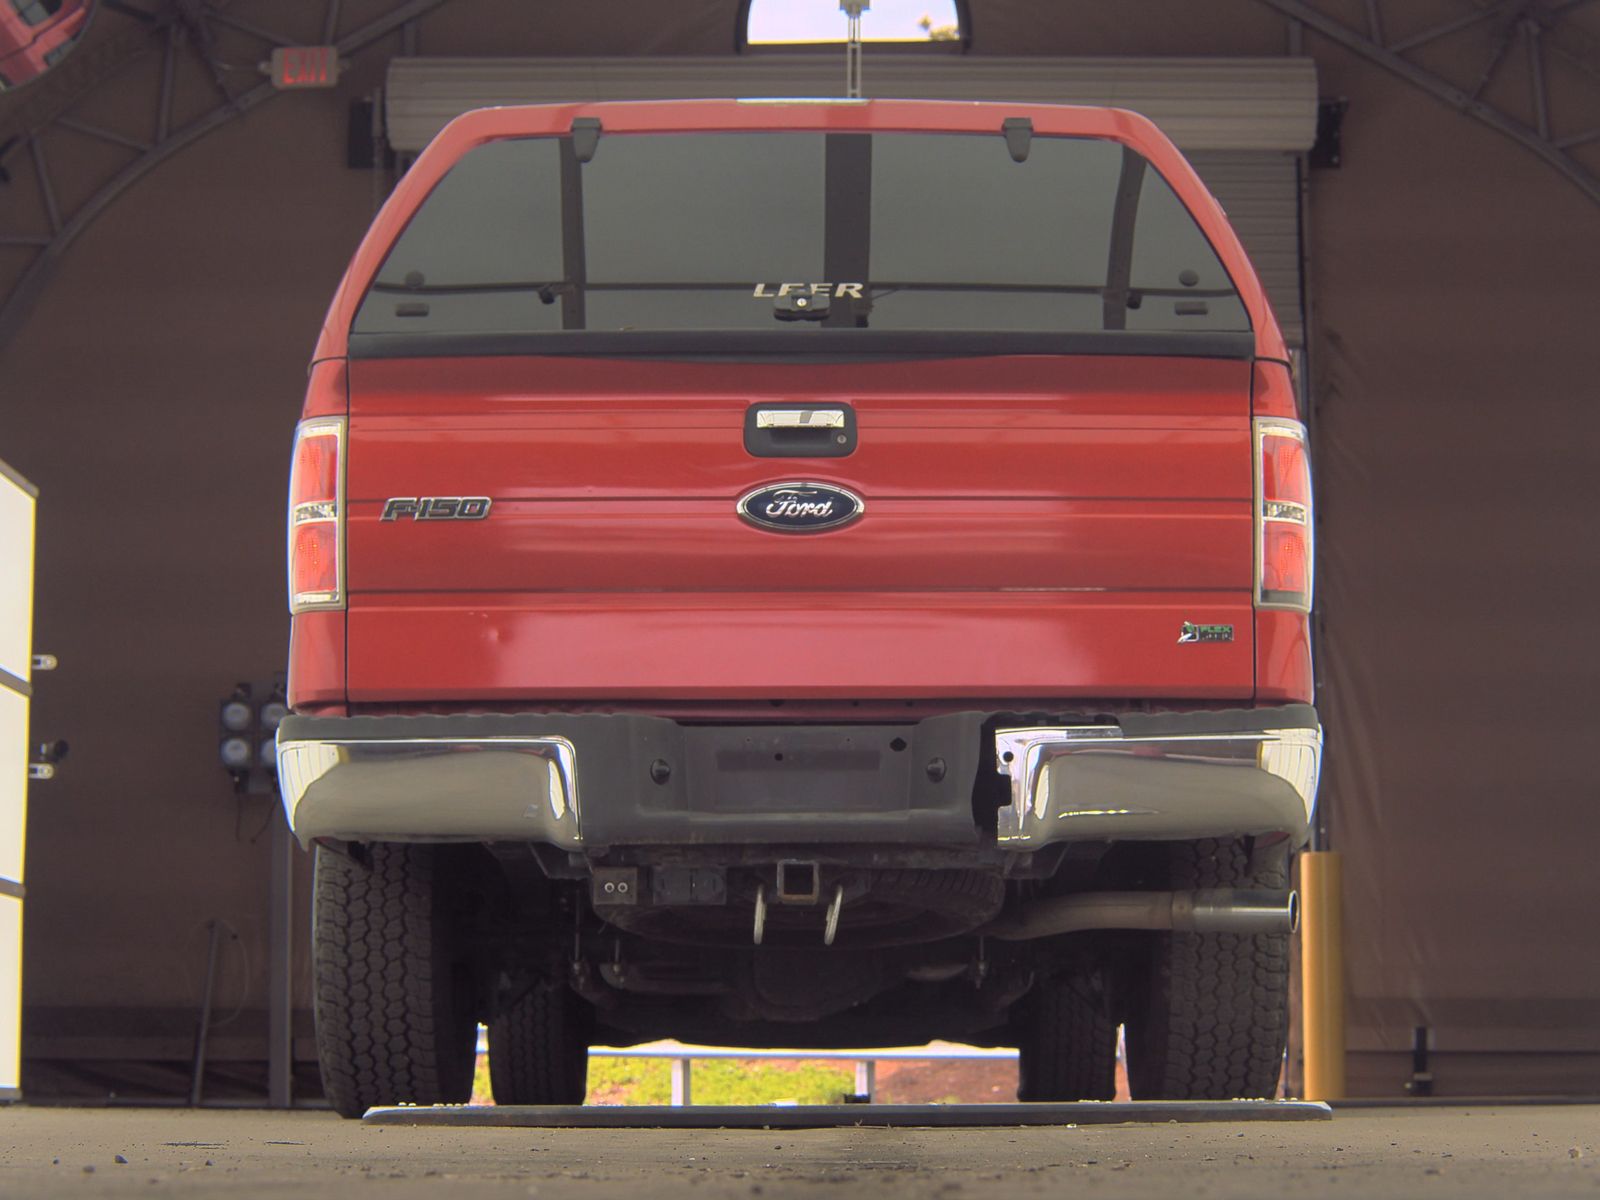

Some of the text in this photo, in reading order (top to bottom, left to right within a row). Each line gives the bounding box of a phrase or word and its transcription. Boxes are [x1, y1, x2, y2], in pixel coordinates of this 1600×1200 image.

[283, 48, 328, 84] EXIT
[379, 496, 492, 521] F-150
[766, 489, 833, 518] Ford
[1200, 625, 1231, 633] FLEX
